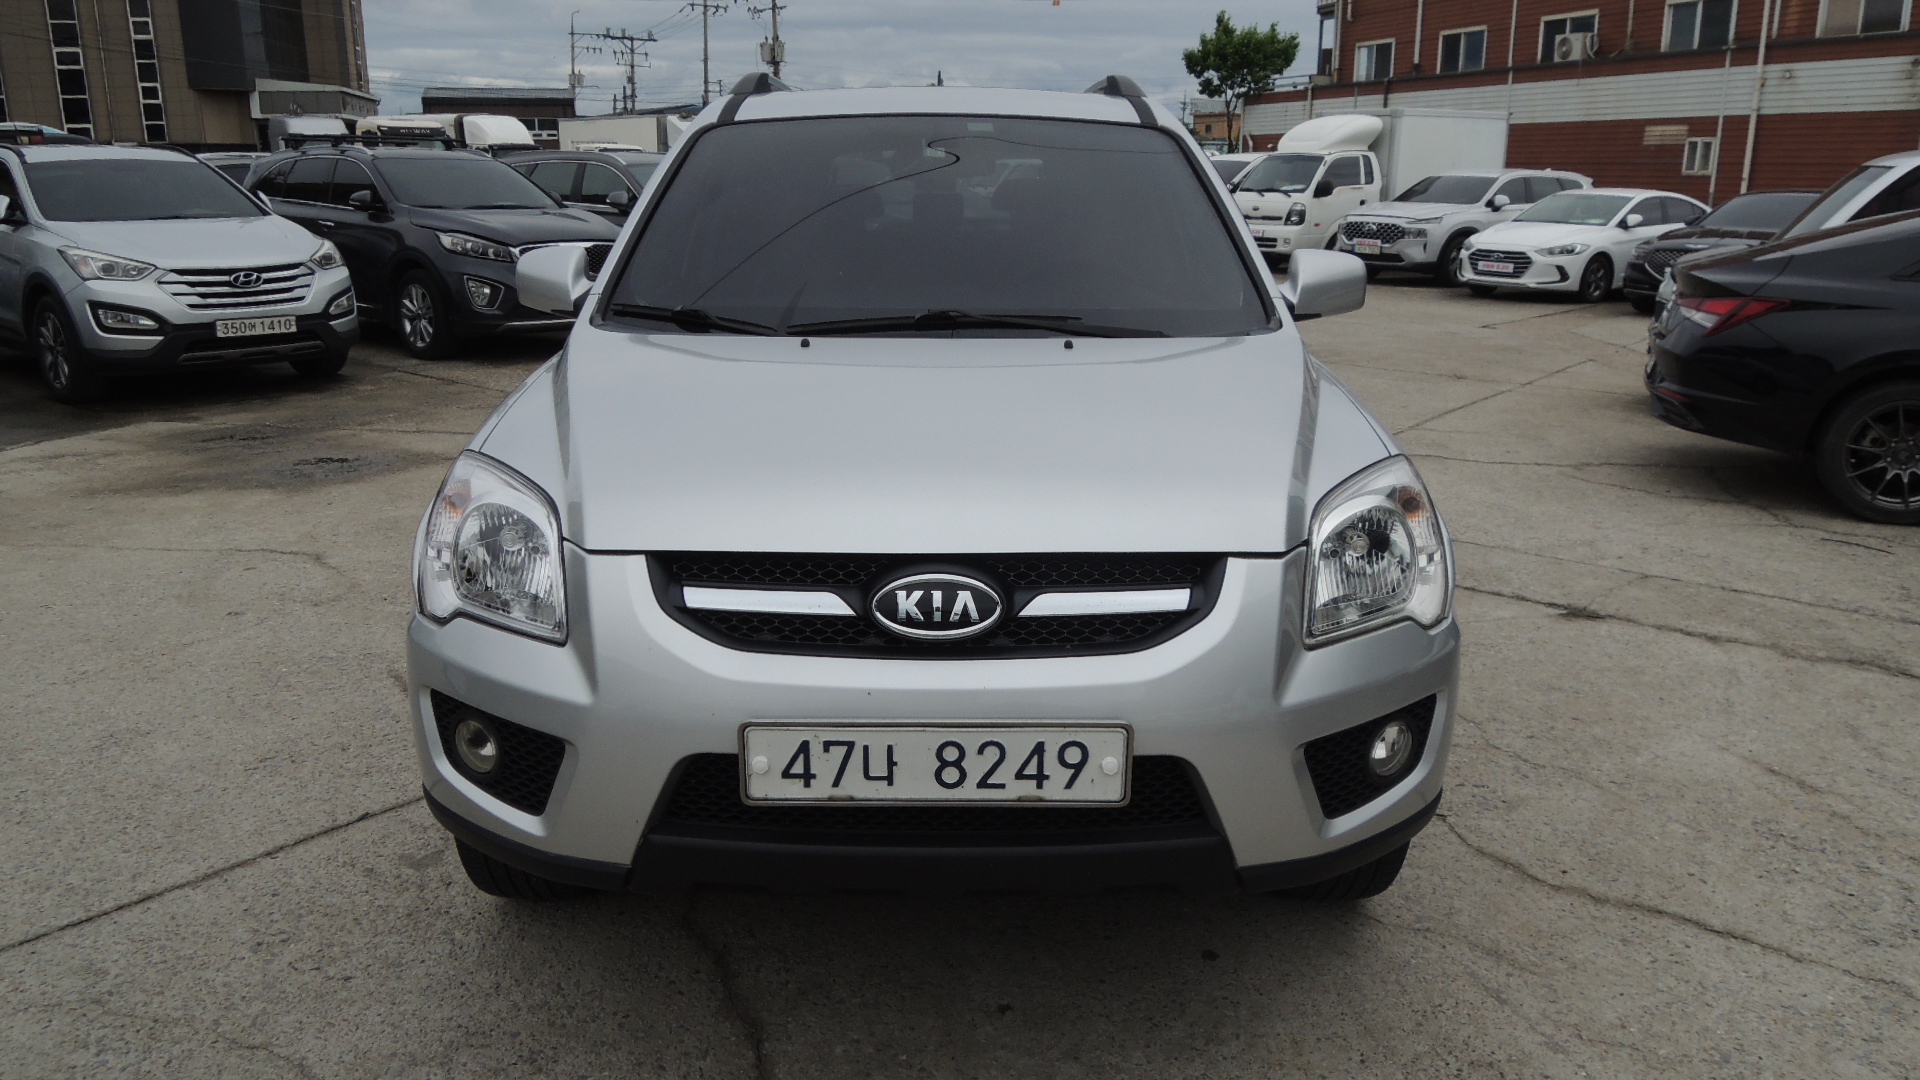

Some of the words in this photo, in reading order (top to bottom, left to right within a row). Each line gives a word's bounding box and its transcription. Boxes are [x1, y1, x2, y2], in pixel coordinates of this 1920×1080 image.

[221, 321, 257, 335] 350어
[260, 318, 292, 333] 1410
[895, 590, 980, 622] KIA
[781, 740, 899, 789] 47나
[933, 740, 1090, 790] 8249
